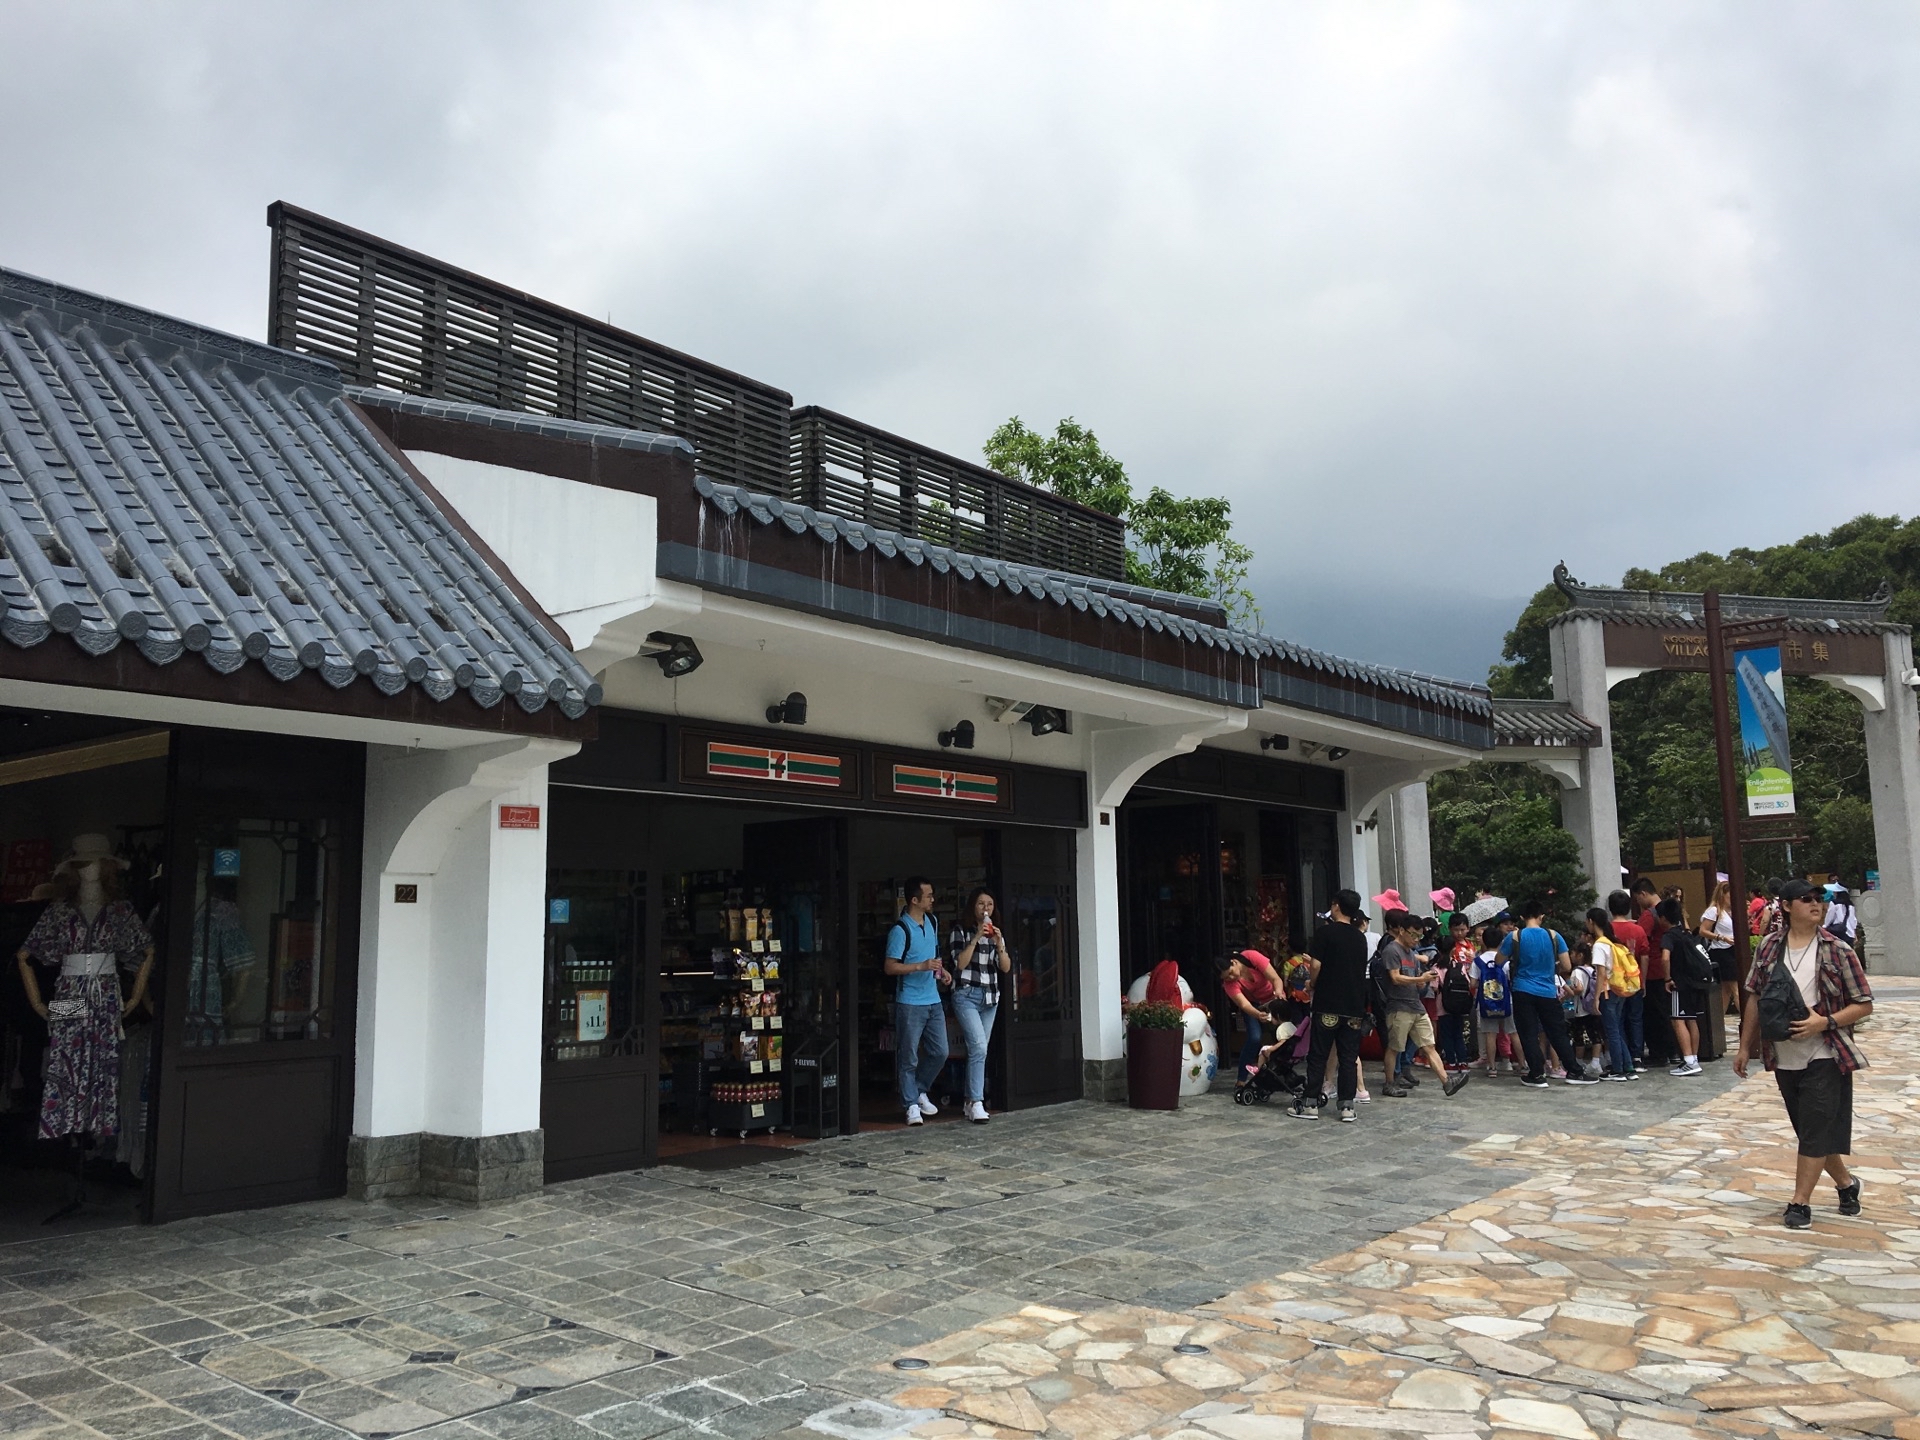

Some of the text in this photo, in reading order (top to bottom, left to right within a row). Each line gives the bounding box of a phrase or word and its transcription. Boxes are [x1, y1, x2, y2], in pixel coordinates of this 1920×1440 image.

[1663, 635, 1700, 643] NGONG
[1748, 778, 1790, 786] Enlightening
[398, 886, 415, 901] 22
